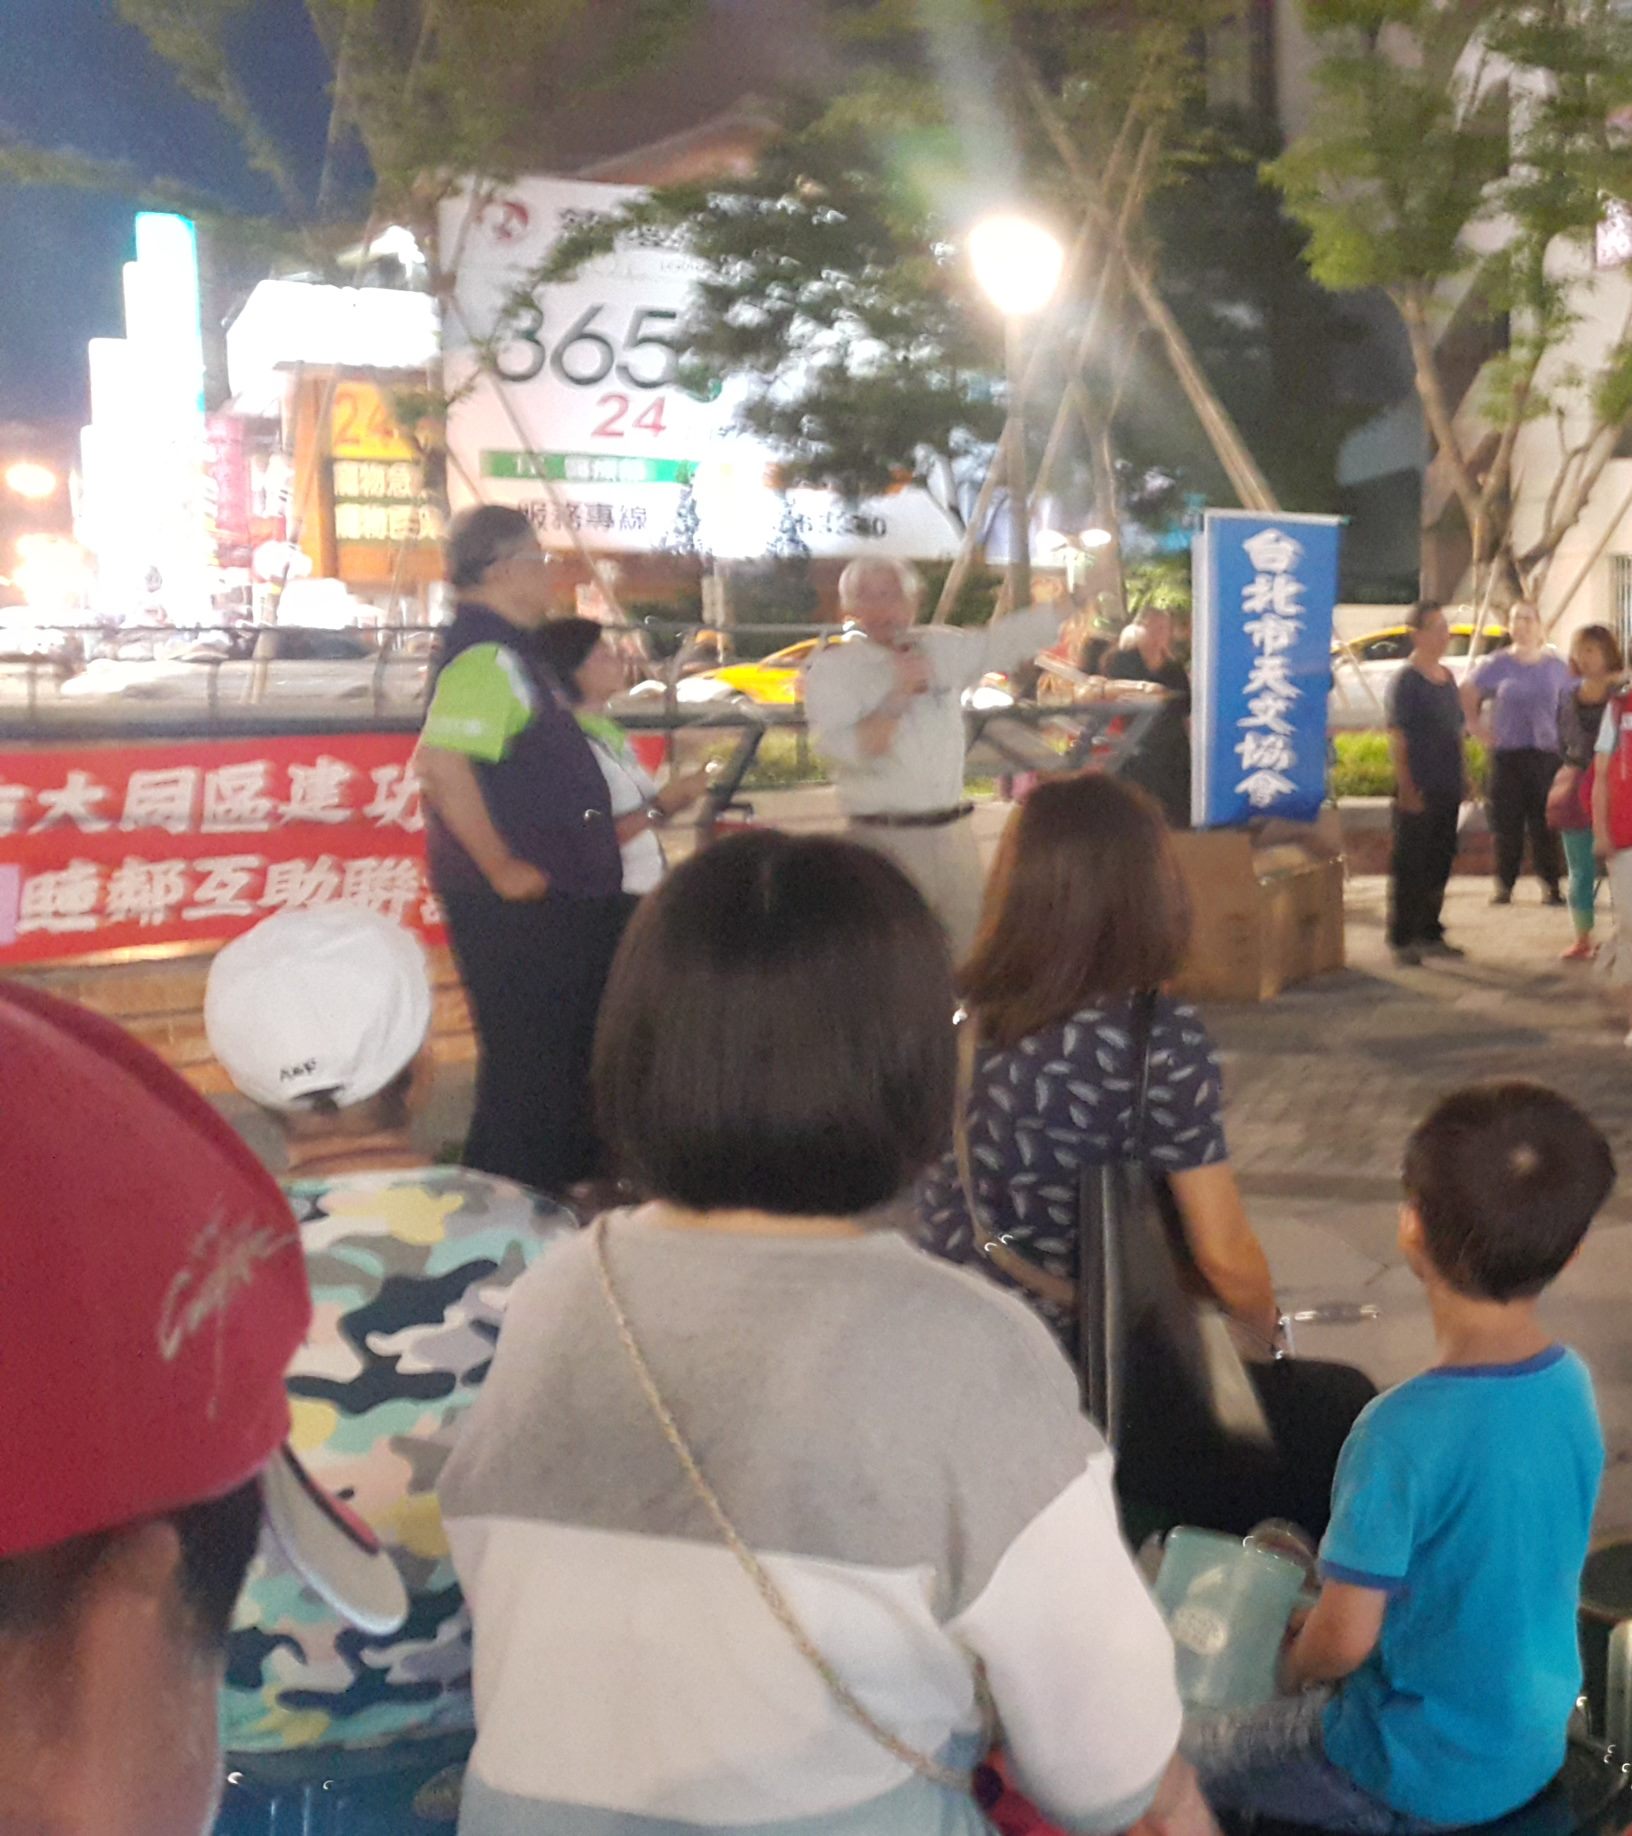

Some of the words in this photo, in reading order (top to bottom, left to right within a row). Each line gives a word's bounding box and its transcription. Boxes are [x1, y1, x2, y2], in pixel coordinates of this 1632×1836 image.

[591, 391, 667, 437] 24
[1234, 527, 1307, 809] 台北市天文協會
